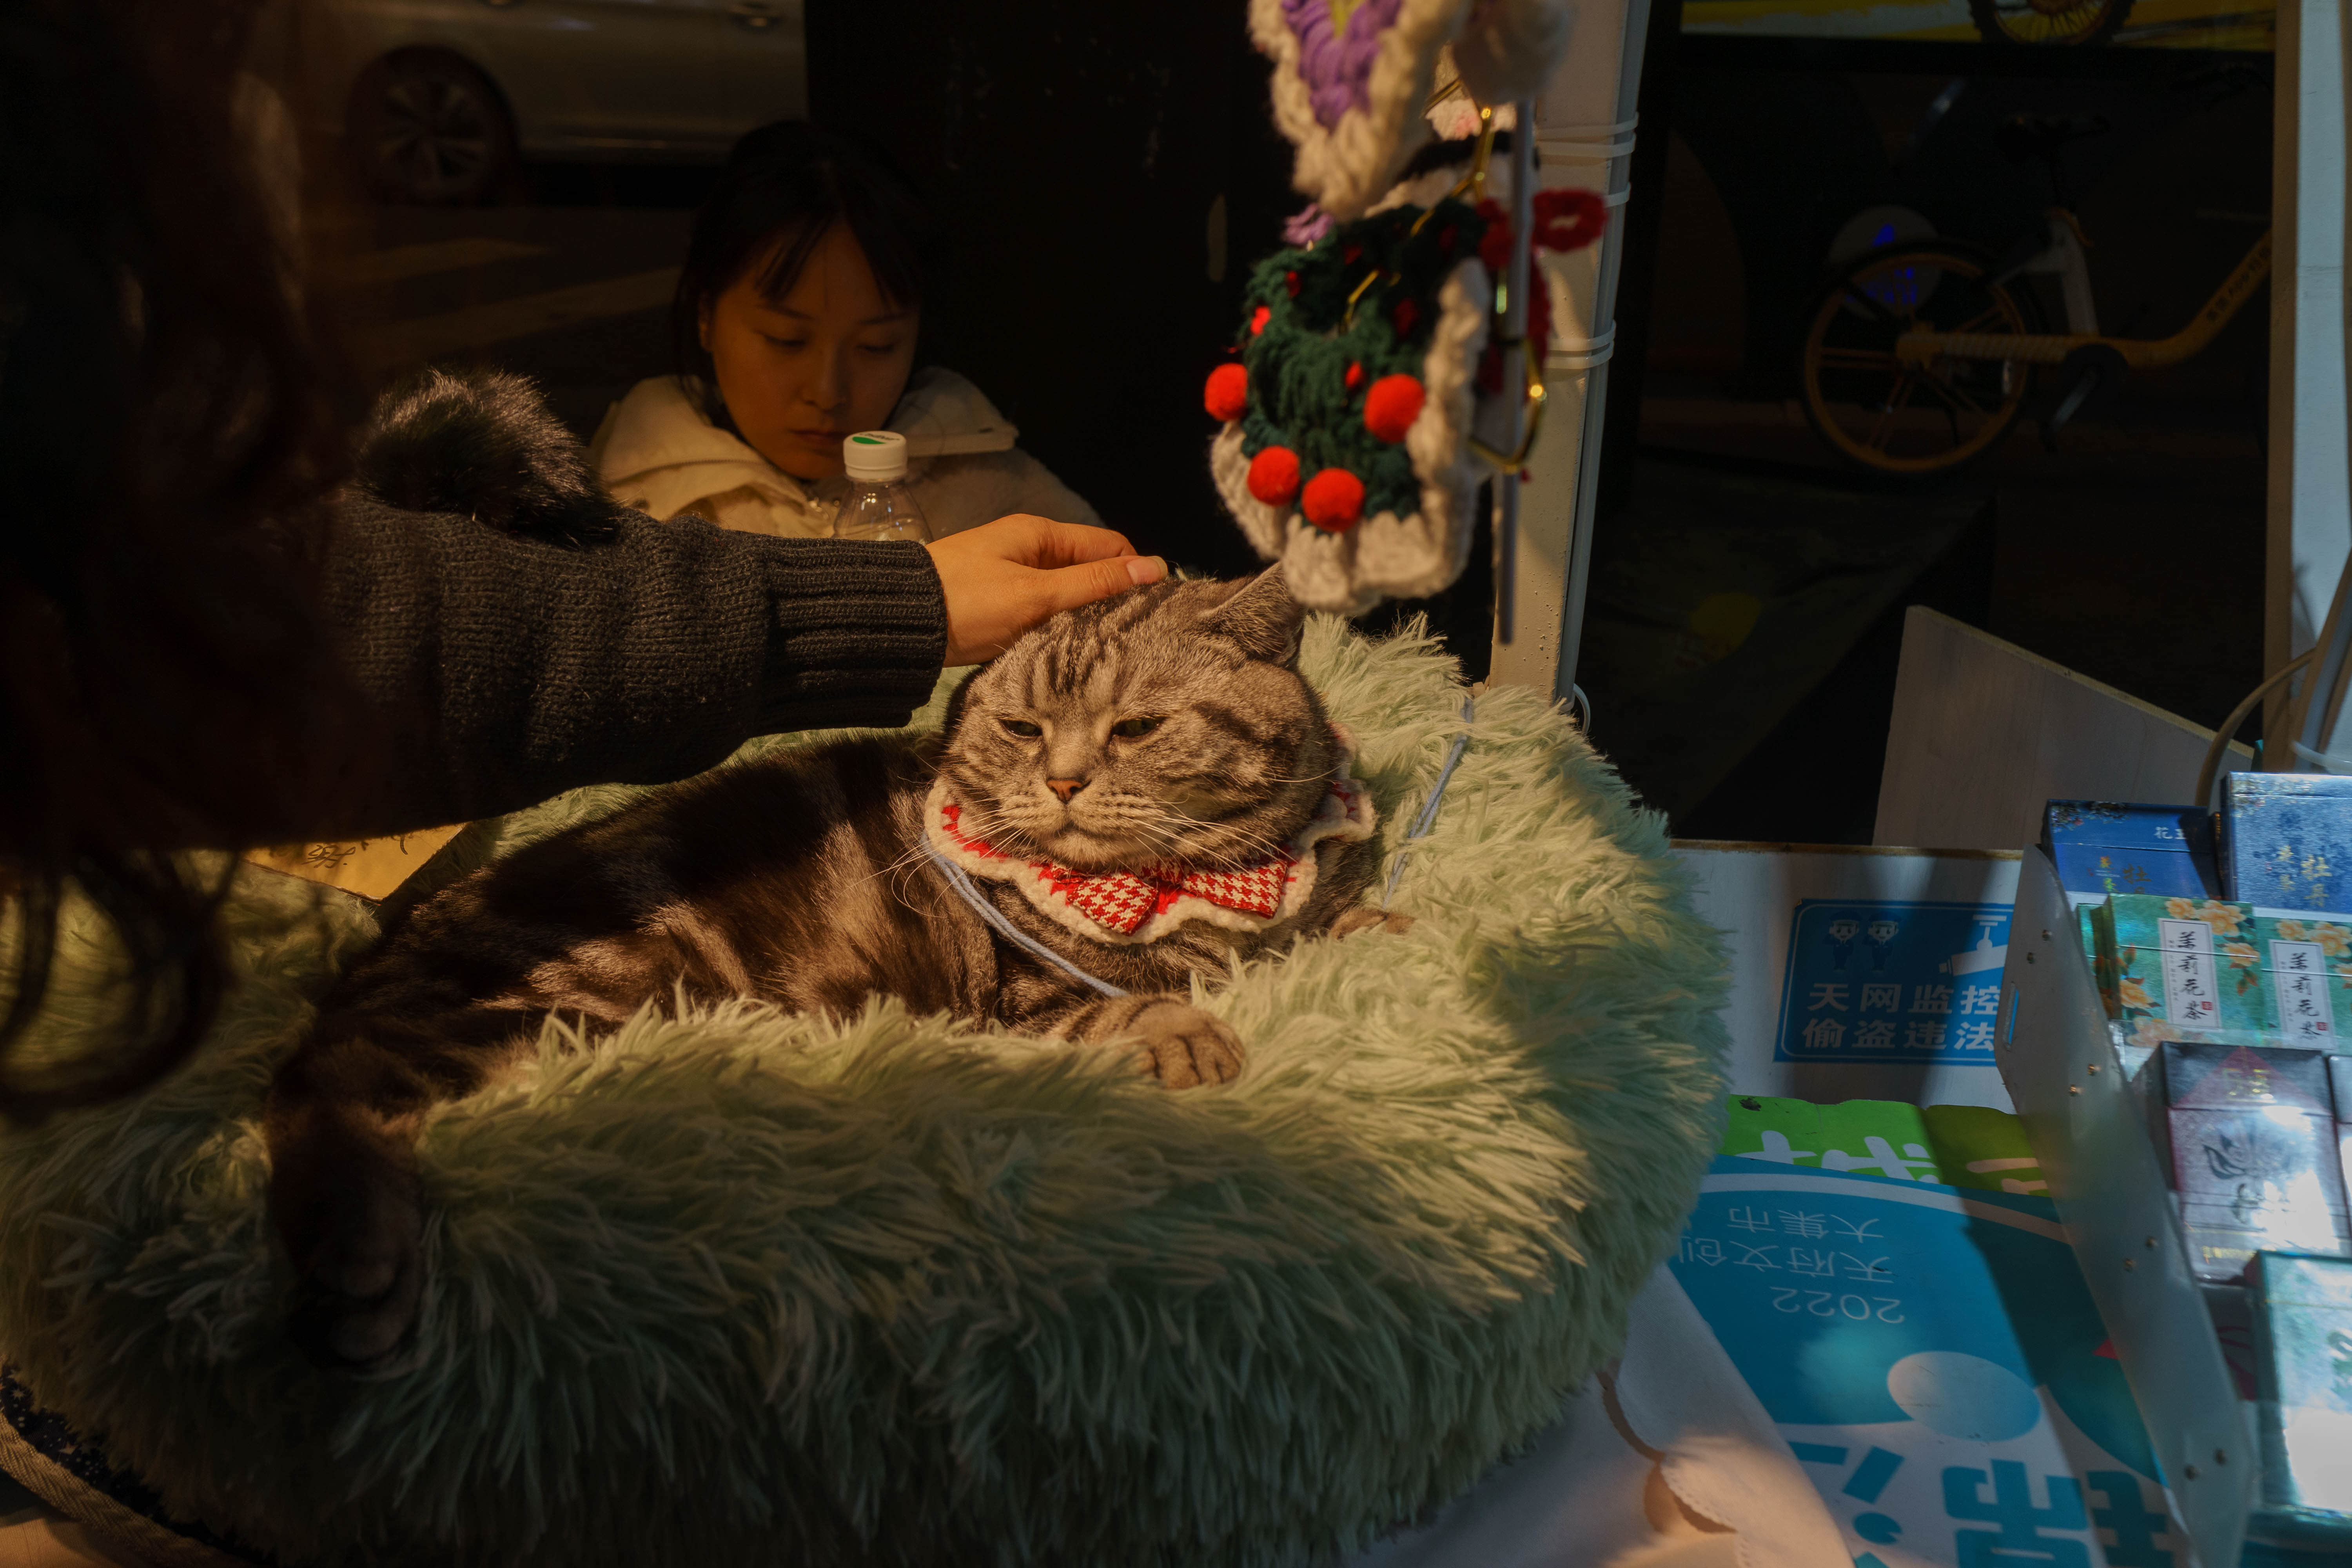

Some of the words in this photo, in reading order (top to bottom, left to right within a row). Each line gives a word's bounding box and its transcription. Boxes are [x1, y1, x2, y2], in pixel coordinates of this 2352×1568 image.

[2178, 931, 2208, 1020] 茉莉花茶
[1807, 983, 2000, 1015] 天网监控
[2290, 953, 2323, 1040] 茉莉花茶
[1802, 1018, 1994, 1052] 偷盗违法
[1726, 1205, 1884, 1243] 大集市
[1678, 1236, 1895, 1283] 天府文创
[1769, 1286, 1906, 1324] 2022
